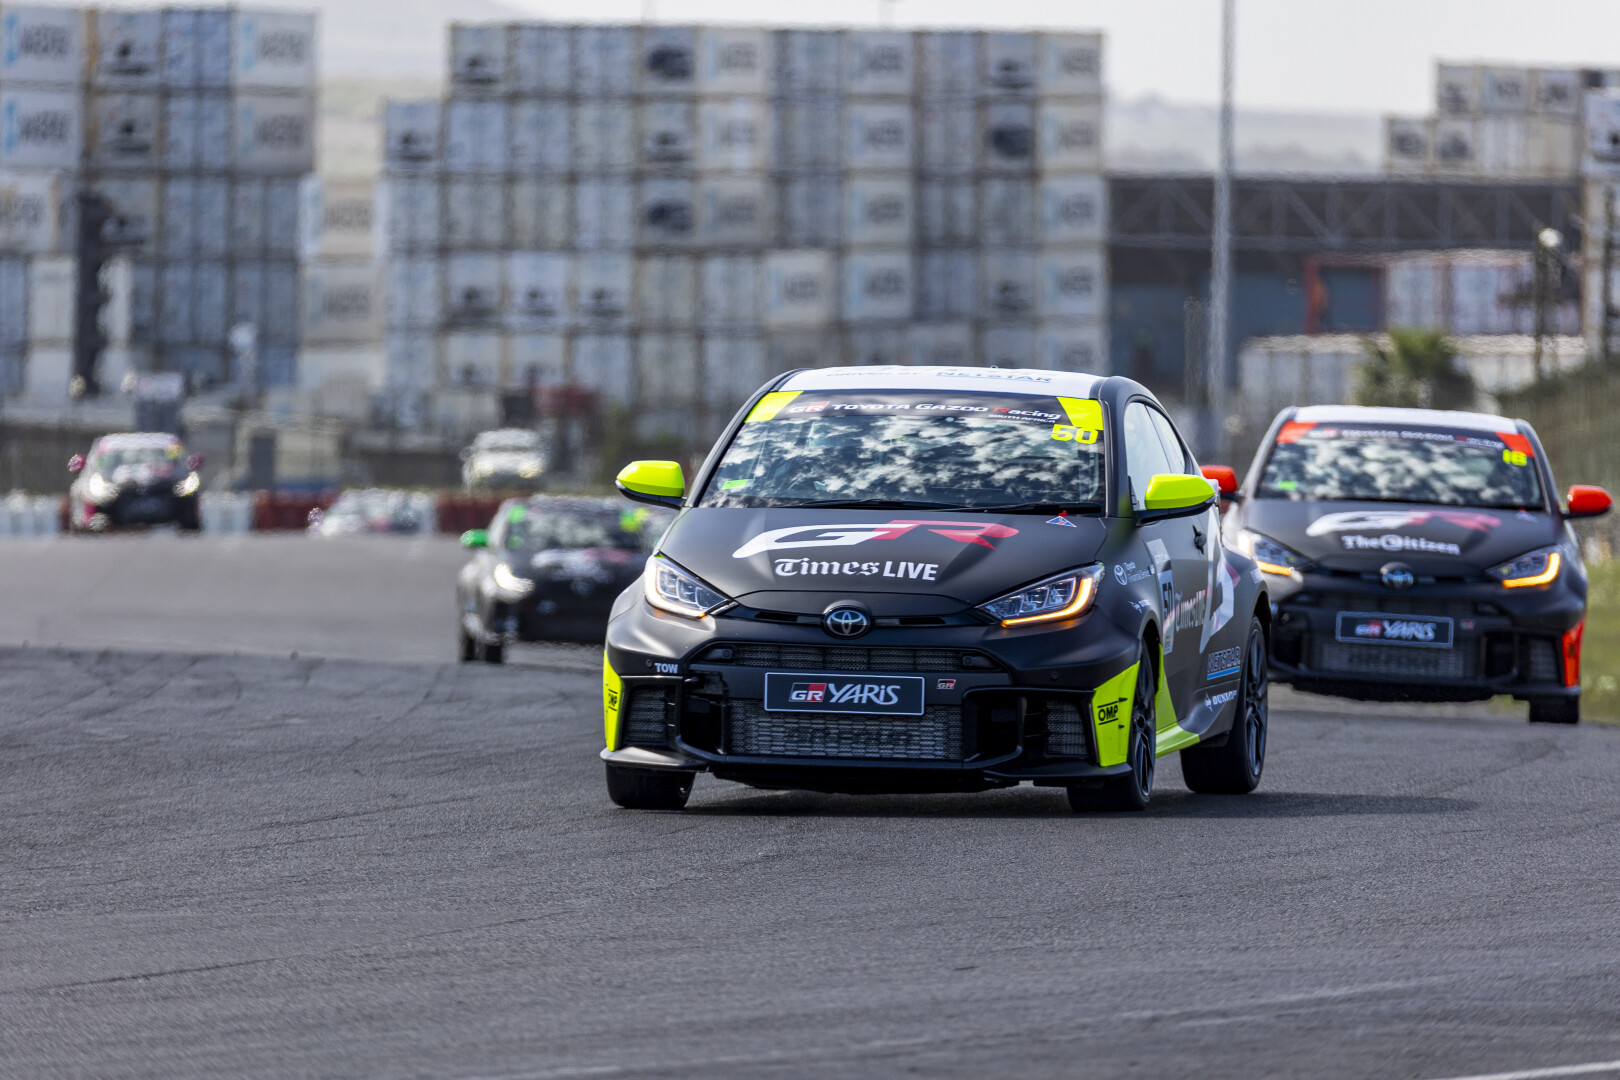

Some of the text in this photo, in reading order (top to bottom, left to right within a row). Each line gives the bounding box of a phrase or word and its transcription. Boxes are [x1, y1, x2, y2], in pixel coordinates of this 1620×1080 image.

[789, 402, 1062, 420] GR TOYOTA GAZOO Racing
[1021, 416, 1056, 424] AFRICA
[1051, 423, 1099, 445] 50
[732, 519, 1019, 559] GR
[654, 662, 679, 674] TOW
[1207, 646, 1241, 673] NETSTAR
[936, 681, 955, 690] GR
[789, 688, 825, 702] GR
[1212, 689, 1238, 705] DUNLOP
[1098, 704, 1119, 722] OMP
